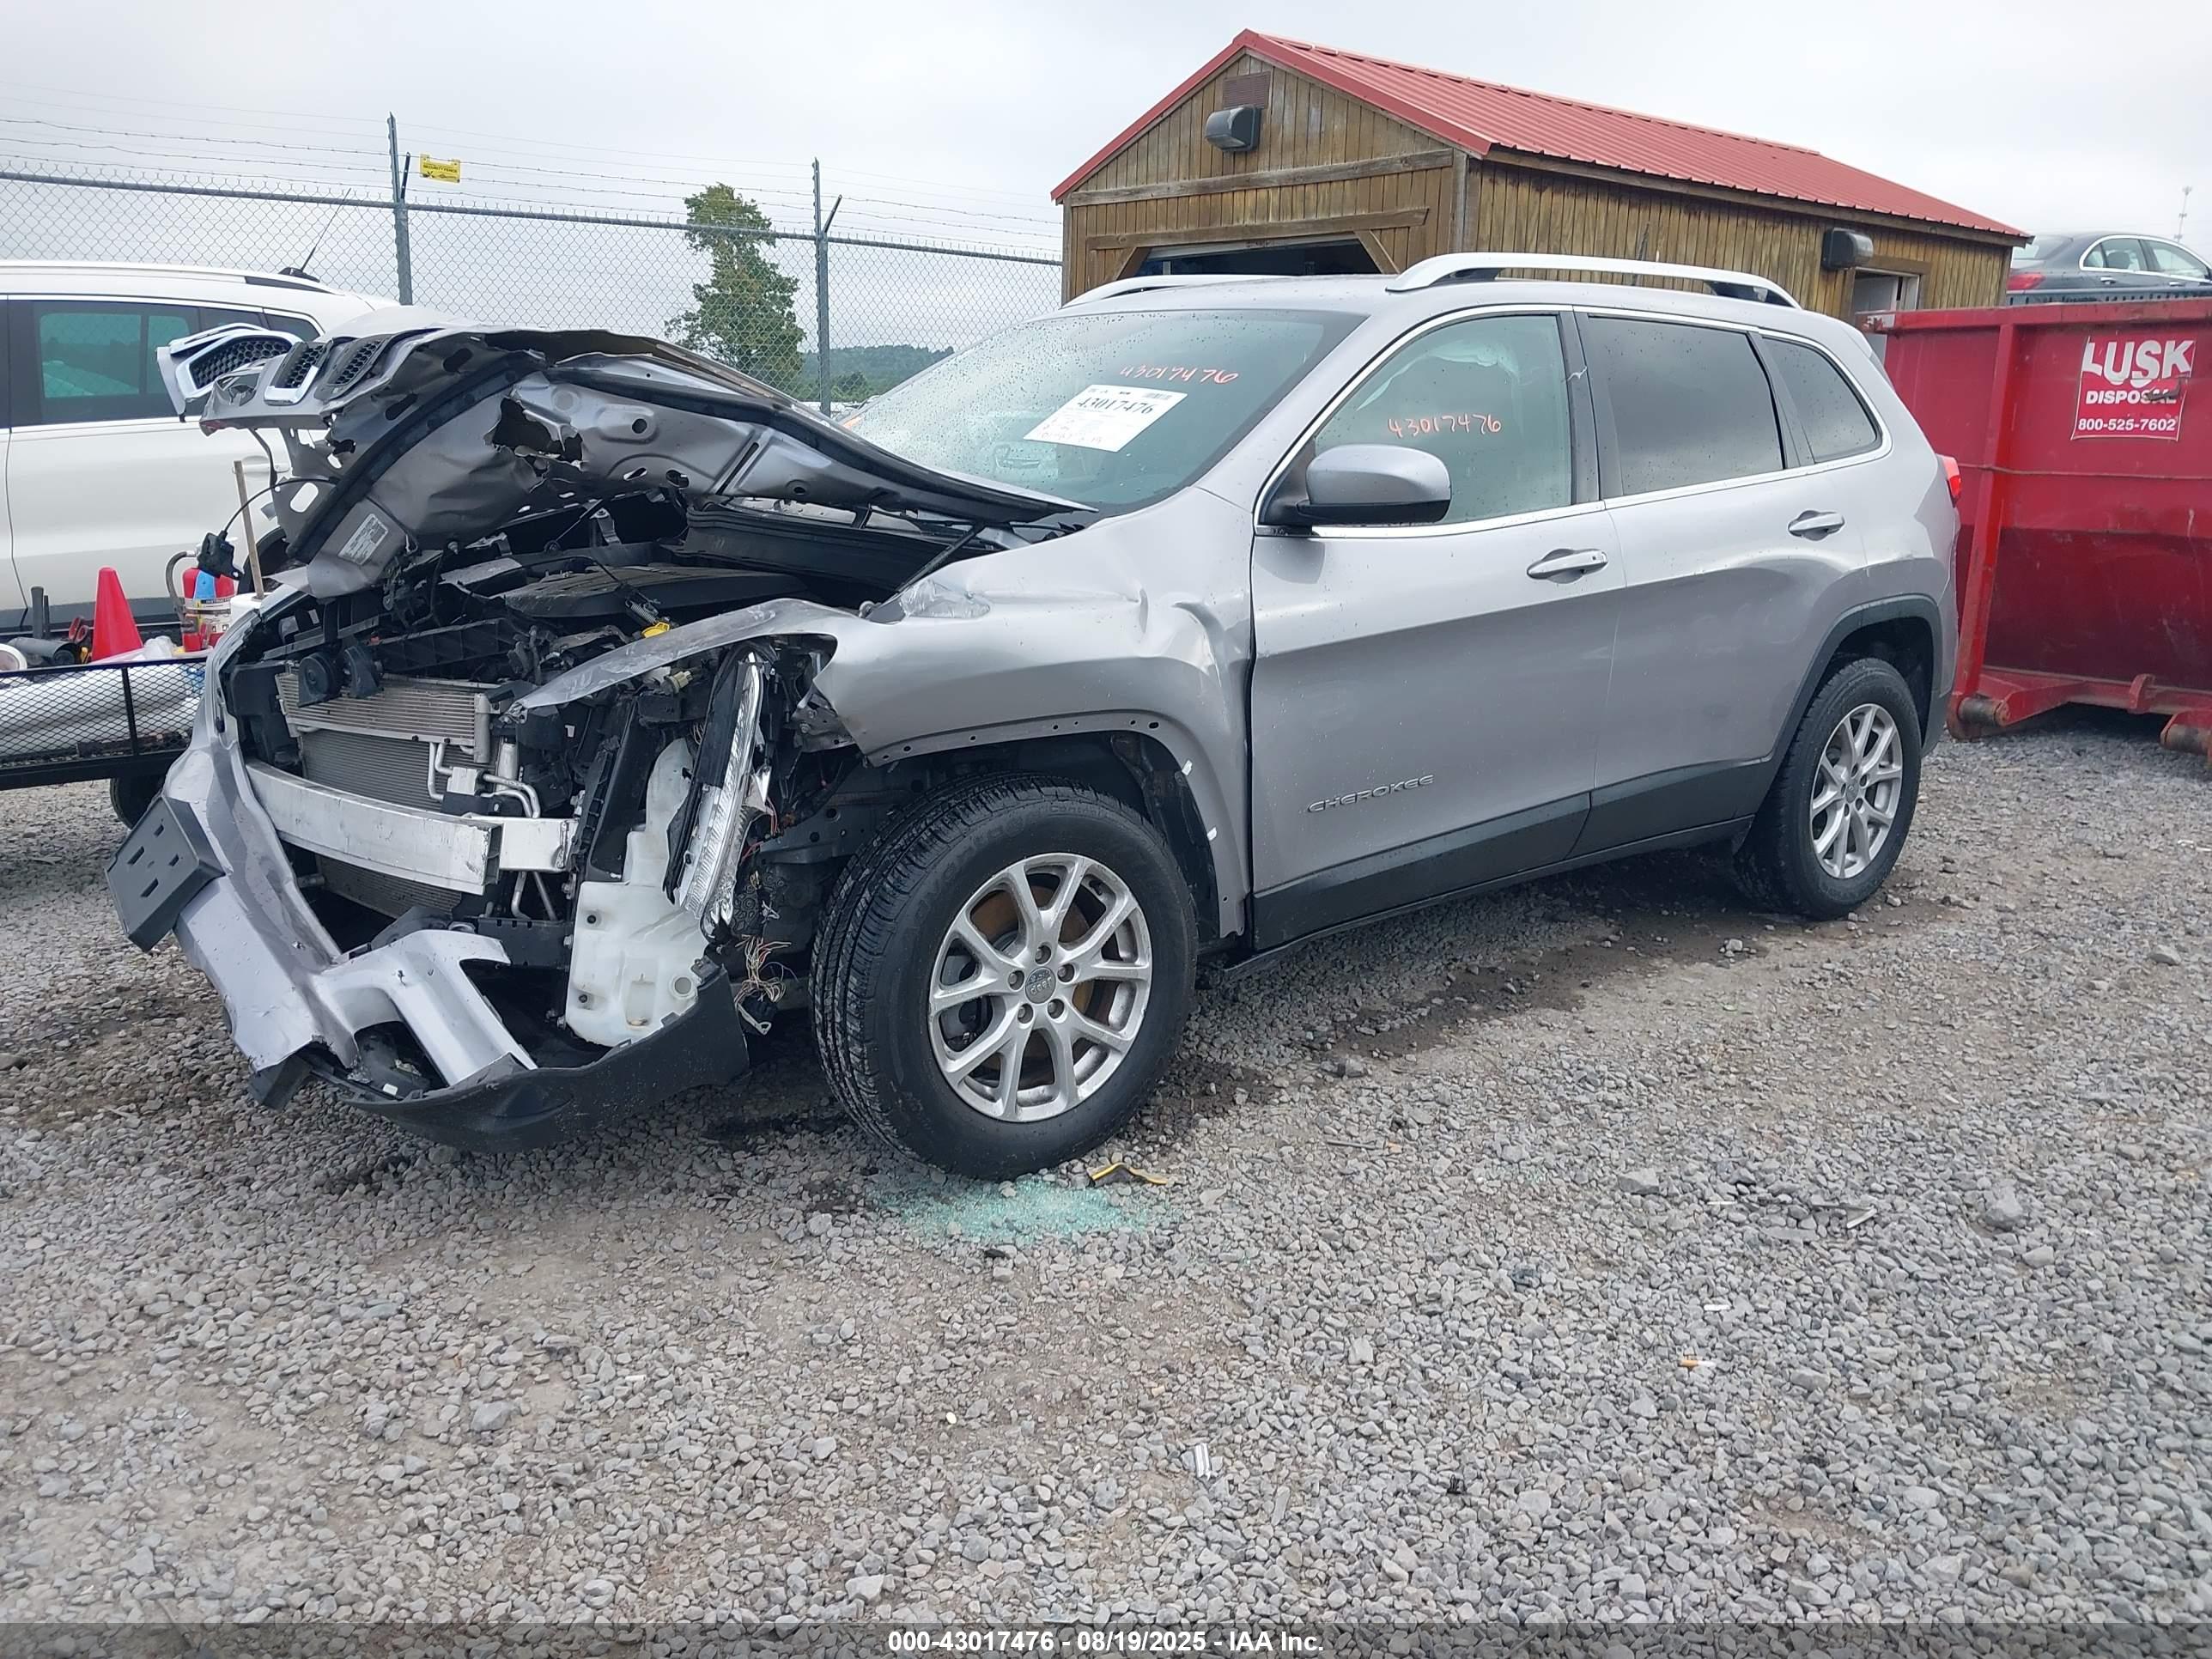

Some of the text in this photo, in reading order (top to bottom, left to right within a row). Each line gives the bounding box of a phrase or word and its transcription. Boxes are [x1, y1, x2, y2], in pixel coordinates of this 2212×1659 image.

[1120, 364, 1239, 385] 43017476
[2081, 340, 2195, 388] LUSK
[1077, 396, 1156, 415] 43017476
[1388, 413, 1502, 438] 43017476
[2078, 418, 2177, 431] 800-525-7602
[1307, 774, 1434, 813] CHEROKEE
